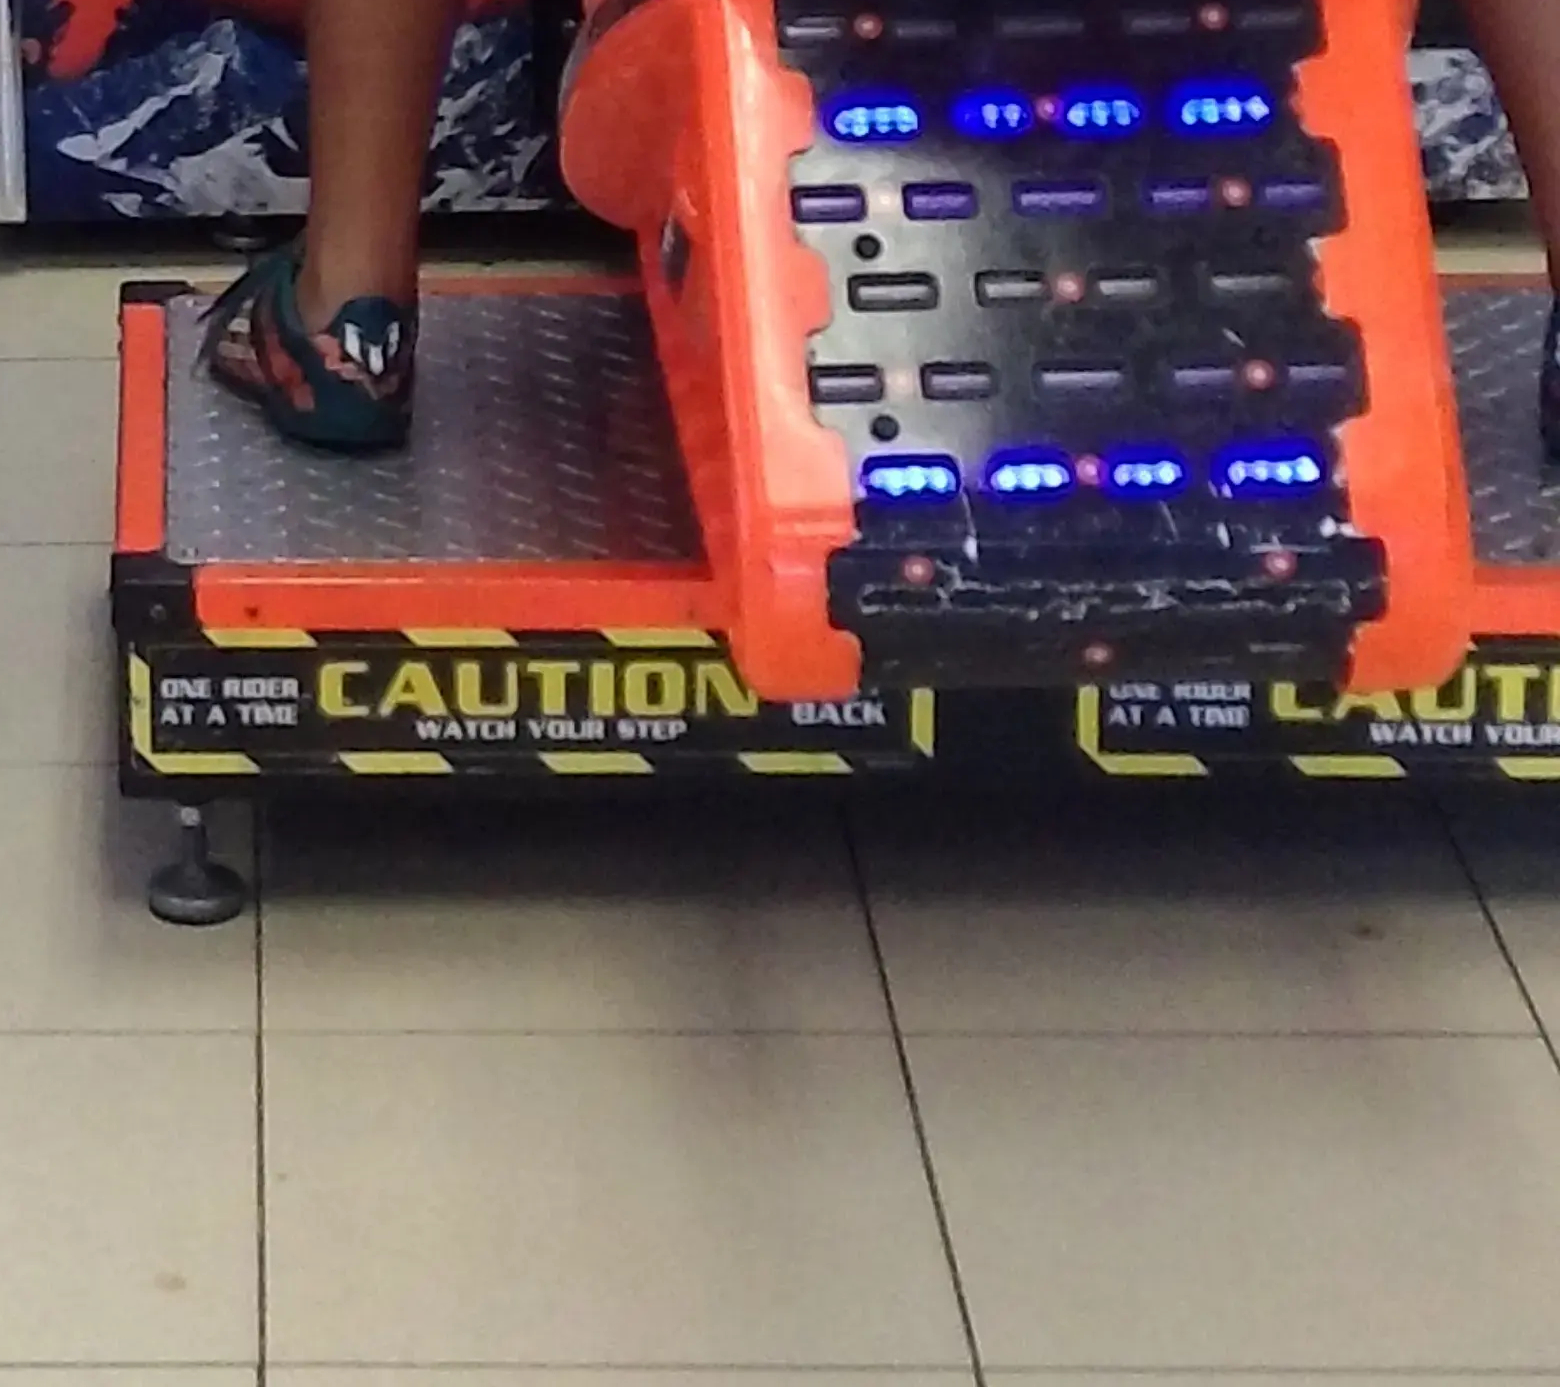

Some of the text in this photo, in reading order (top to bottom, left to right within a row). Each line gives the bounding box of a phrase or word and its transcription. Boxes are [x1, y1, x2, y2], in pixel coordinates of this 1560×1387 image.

[160, 677, 299, 700] ONE RIDER
[320, 661, 759, 718] CAUTION
[160, 704, 299, 727] AT A TIME
[791, 701, 886, 726] BACK
[1108, 704, 1143, 727] AT
[1156, 705, 1177, 726] A
[415, 717, 688, 741] WATCH YOUR STEP
[1368, 721, 1560, 746] WATCH YOUR
